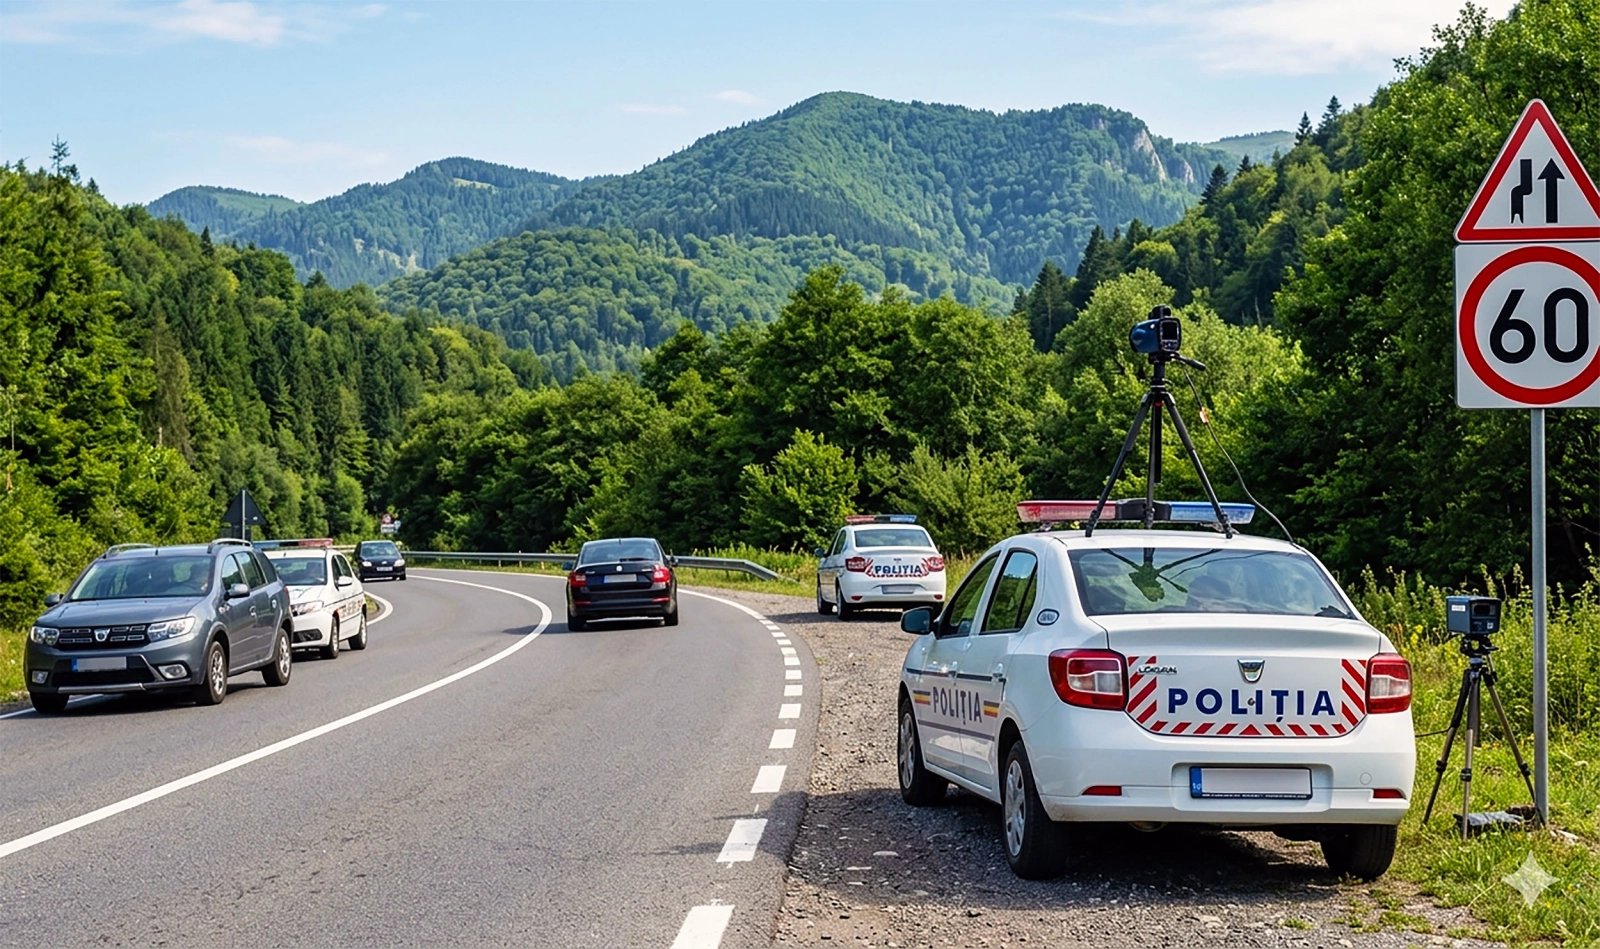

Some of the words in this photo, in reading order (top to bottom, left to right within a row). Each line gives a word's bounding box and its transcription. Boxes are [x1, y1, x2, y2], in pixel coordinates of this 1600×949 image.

[1490, 288, 1589, 364] 60
[932, 686, 983, 725] POLIȚIA
[1168, 688, 1336, 723] POLIȚIA
